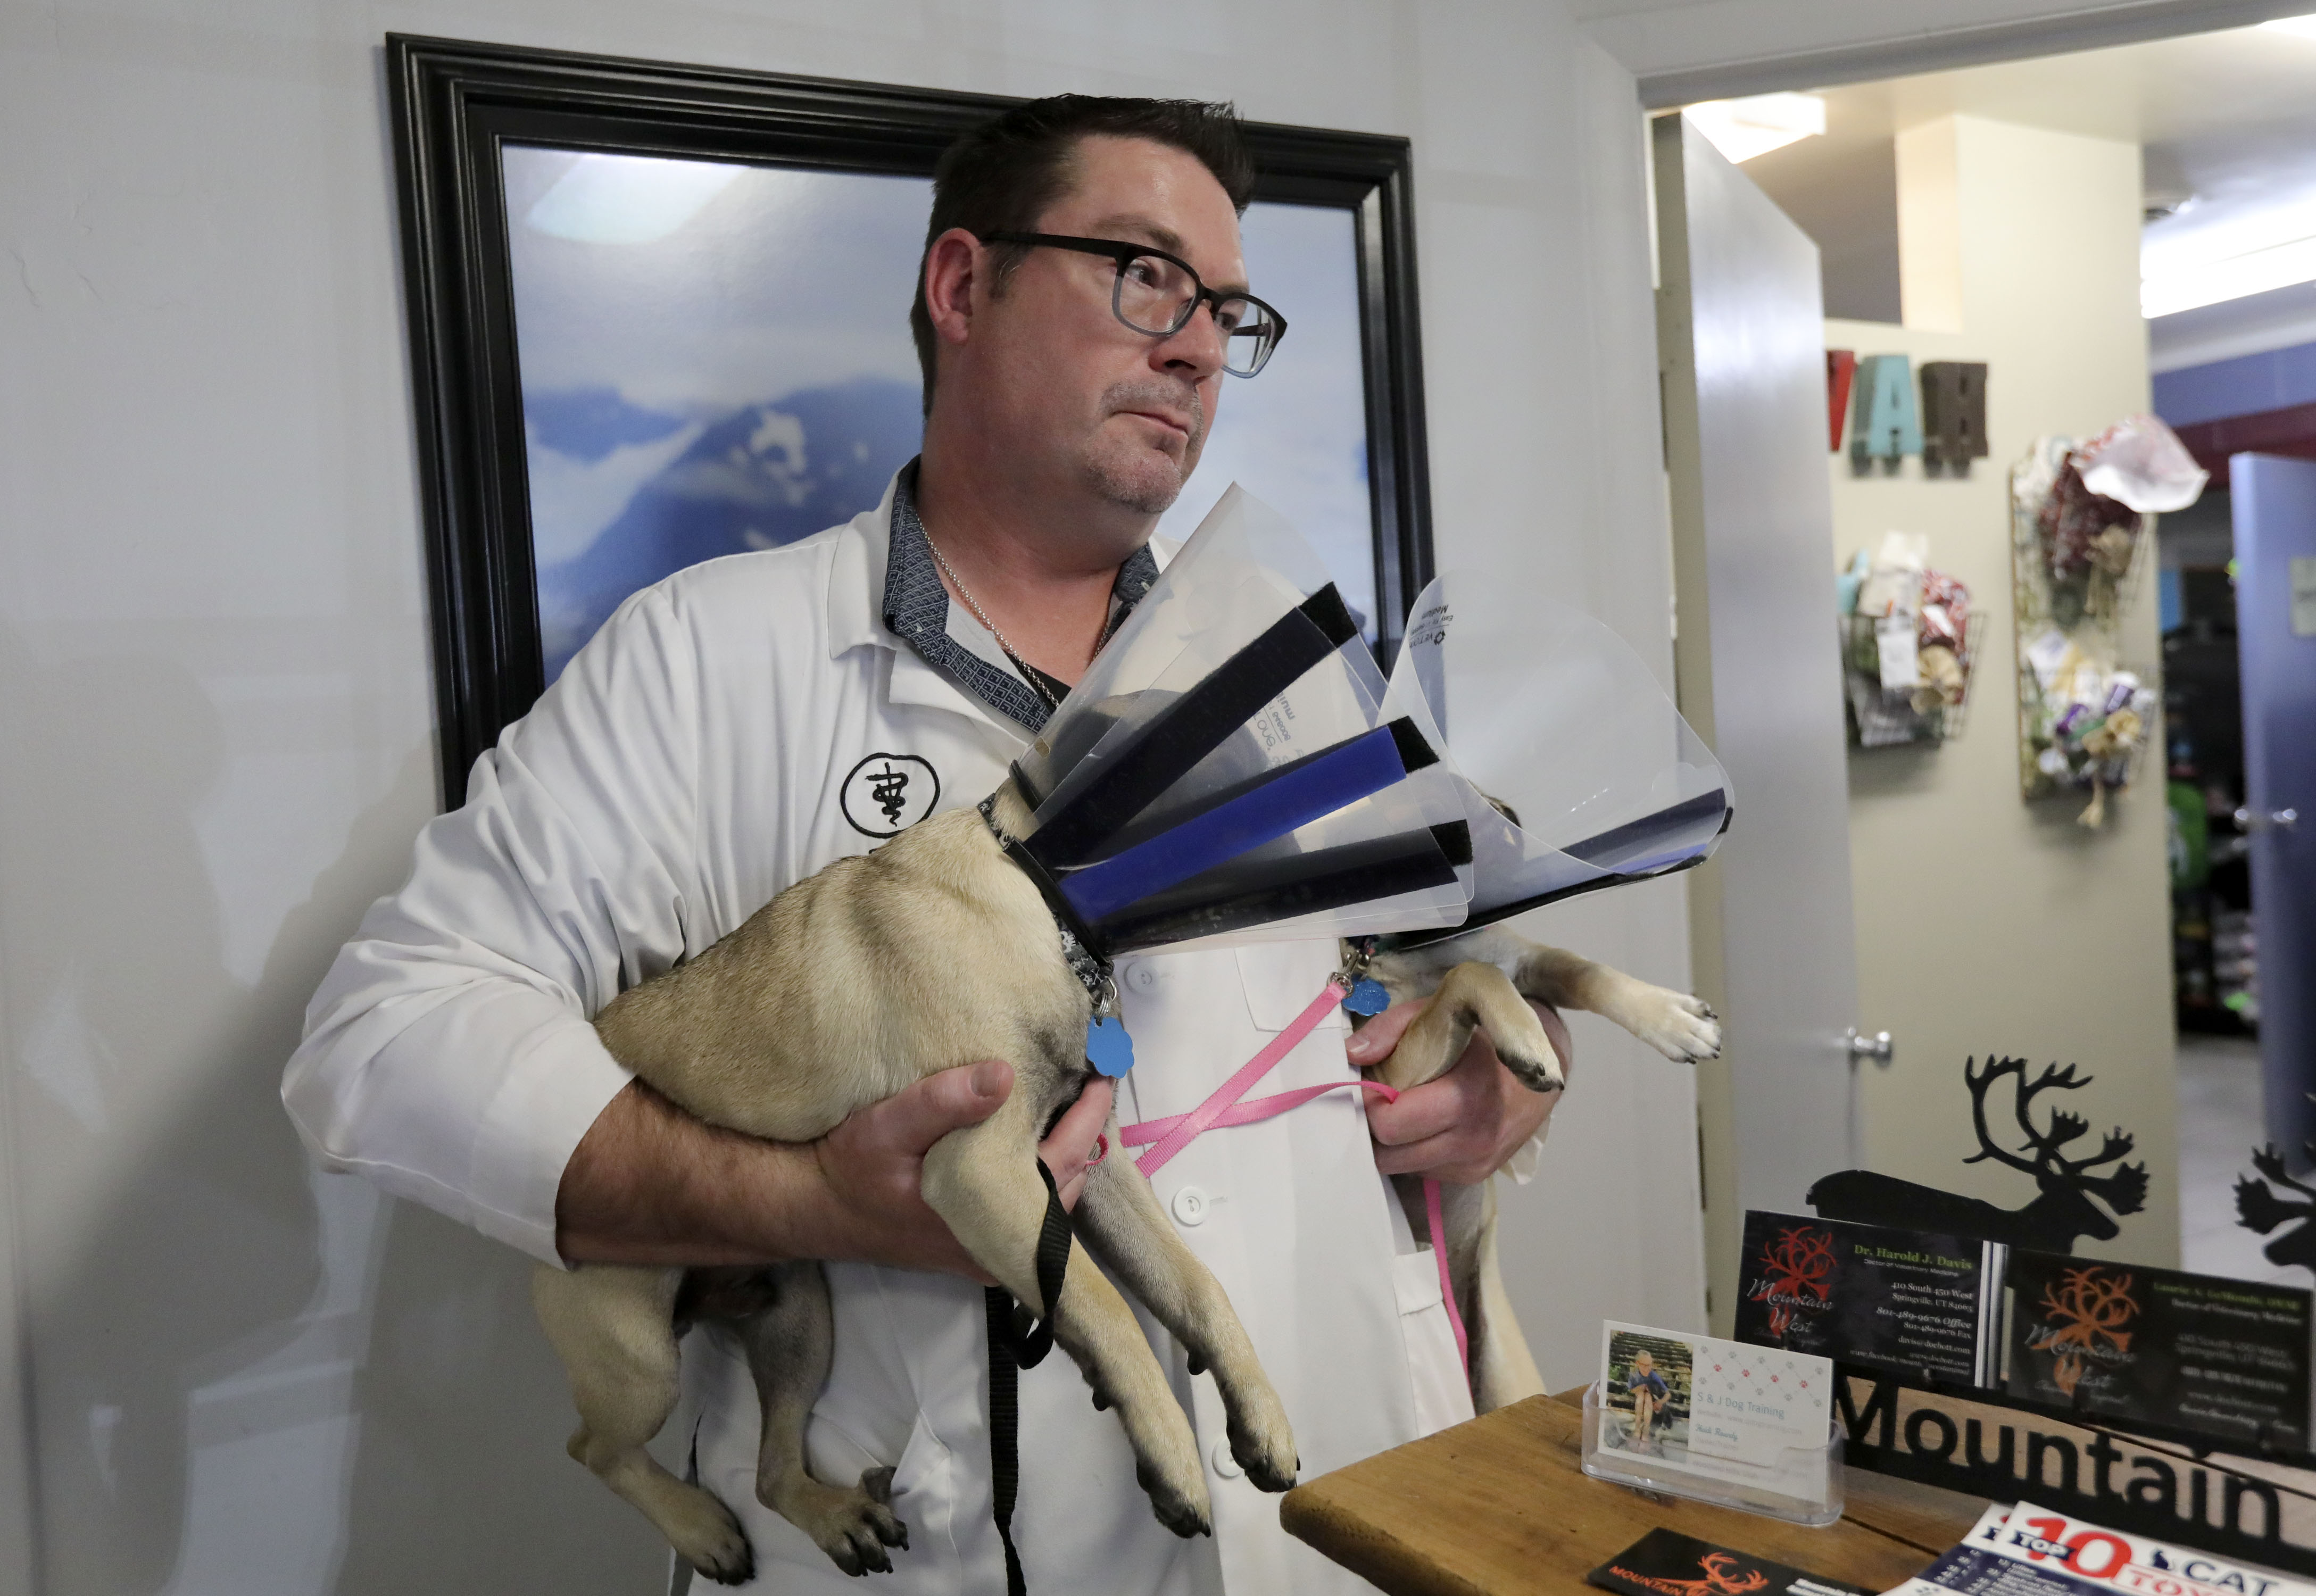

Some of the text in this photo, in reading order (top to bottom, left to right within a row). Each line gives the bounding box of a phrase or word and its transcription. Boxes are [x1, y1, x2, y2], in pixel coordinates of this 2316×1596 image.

[1854, 1244, 1973, 1270] Dr. Harold J. Davis
[1907, 1283, 1932, 1293] South
[1951, 1289, 1973, 1300] West
[1943, 1317, 1972, 1328] Office
[1698, 1392, 1784, 1419] S & J Dog Training
[1831, 1374, 2282, 1543] Mountain
[2020, 1533, 2068, 1557] TOP
[2027, 1517, 2131, 1578] 10
[1609, 1566, 1684, 1596] MOUNTAIN
[2184, 1561, 2279, 1596] CAT
